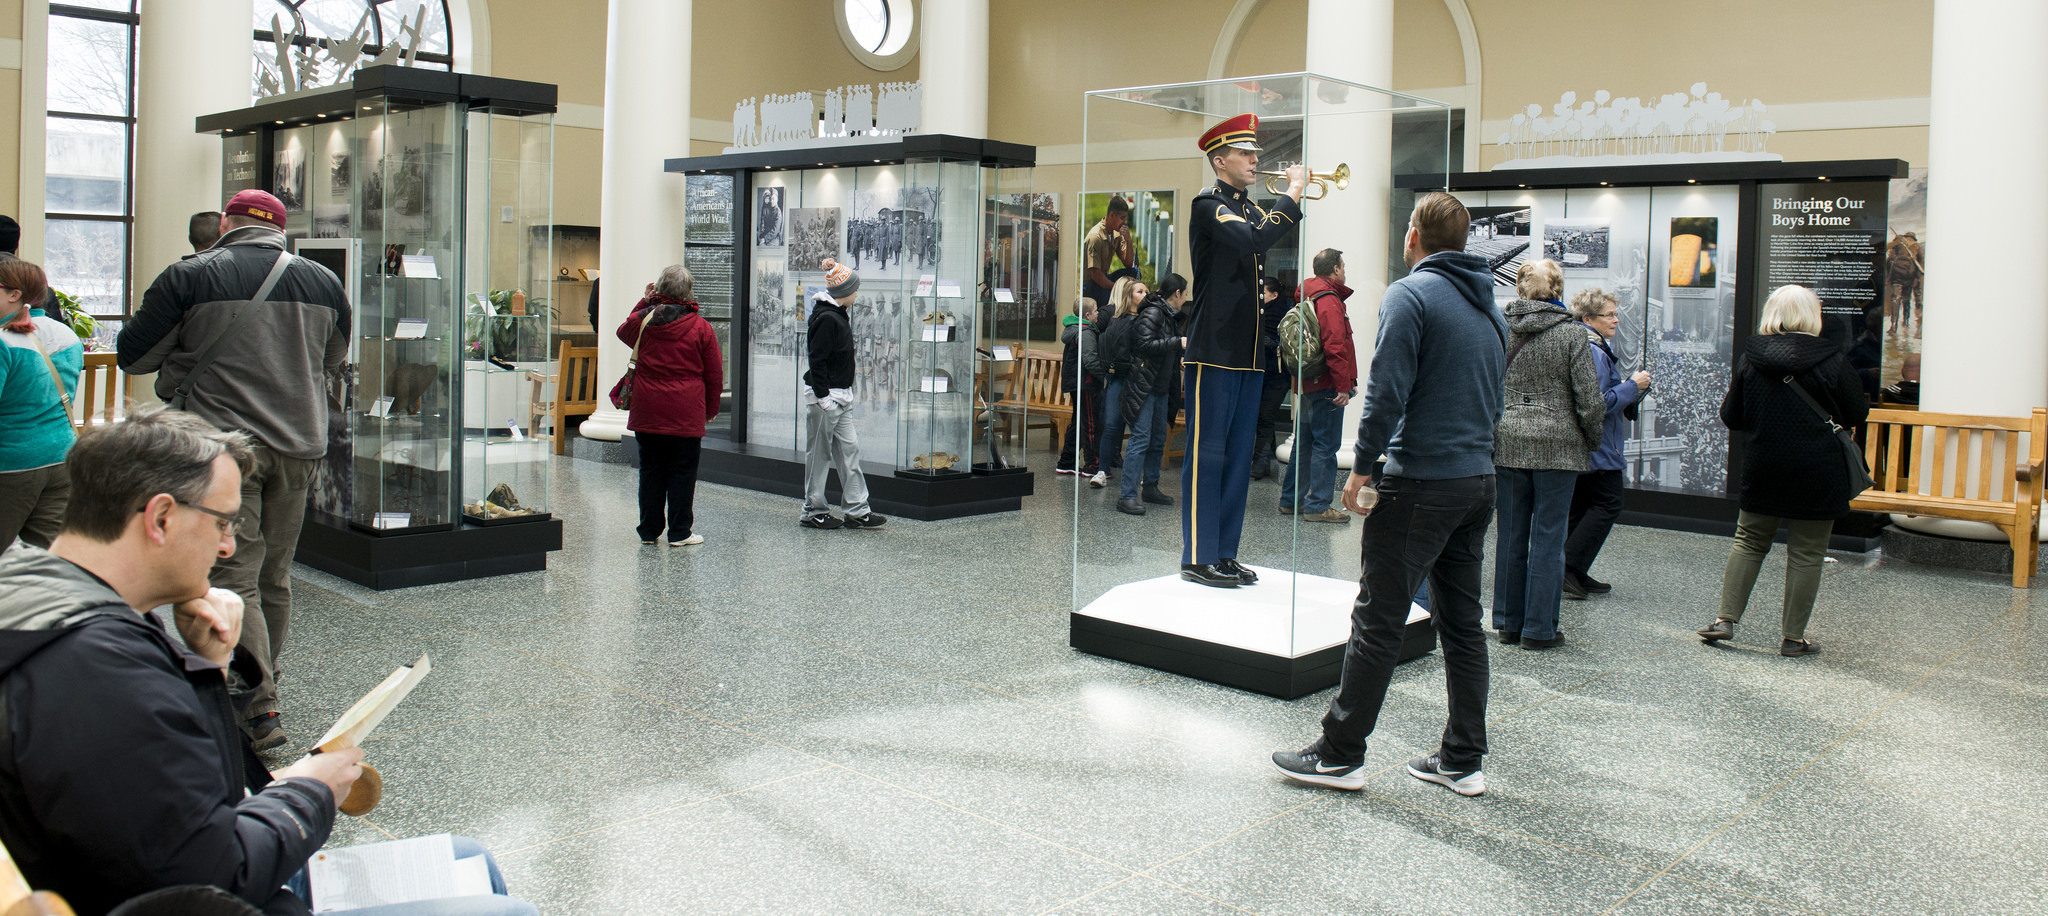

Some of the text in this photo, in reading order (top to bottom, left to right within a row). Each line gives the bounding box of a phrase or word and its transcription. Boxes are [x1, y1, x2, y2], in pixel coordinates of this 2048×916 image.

[691, 199, 733, 211] Americans in
[1772, 197, 1865, 213] Bringing Our
[691, 213, 710, 224] World
[711, 213, 725, 224] War
[1772, 213, 1851, 229] Boys Home
